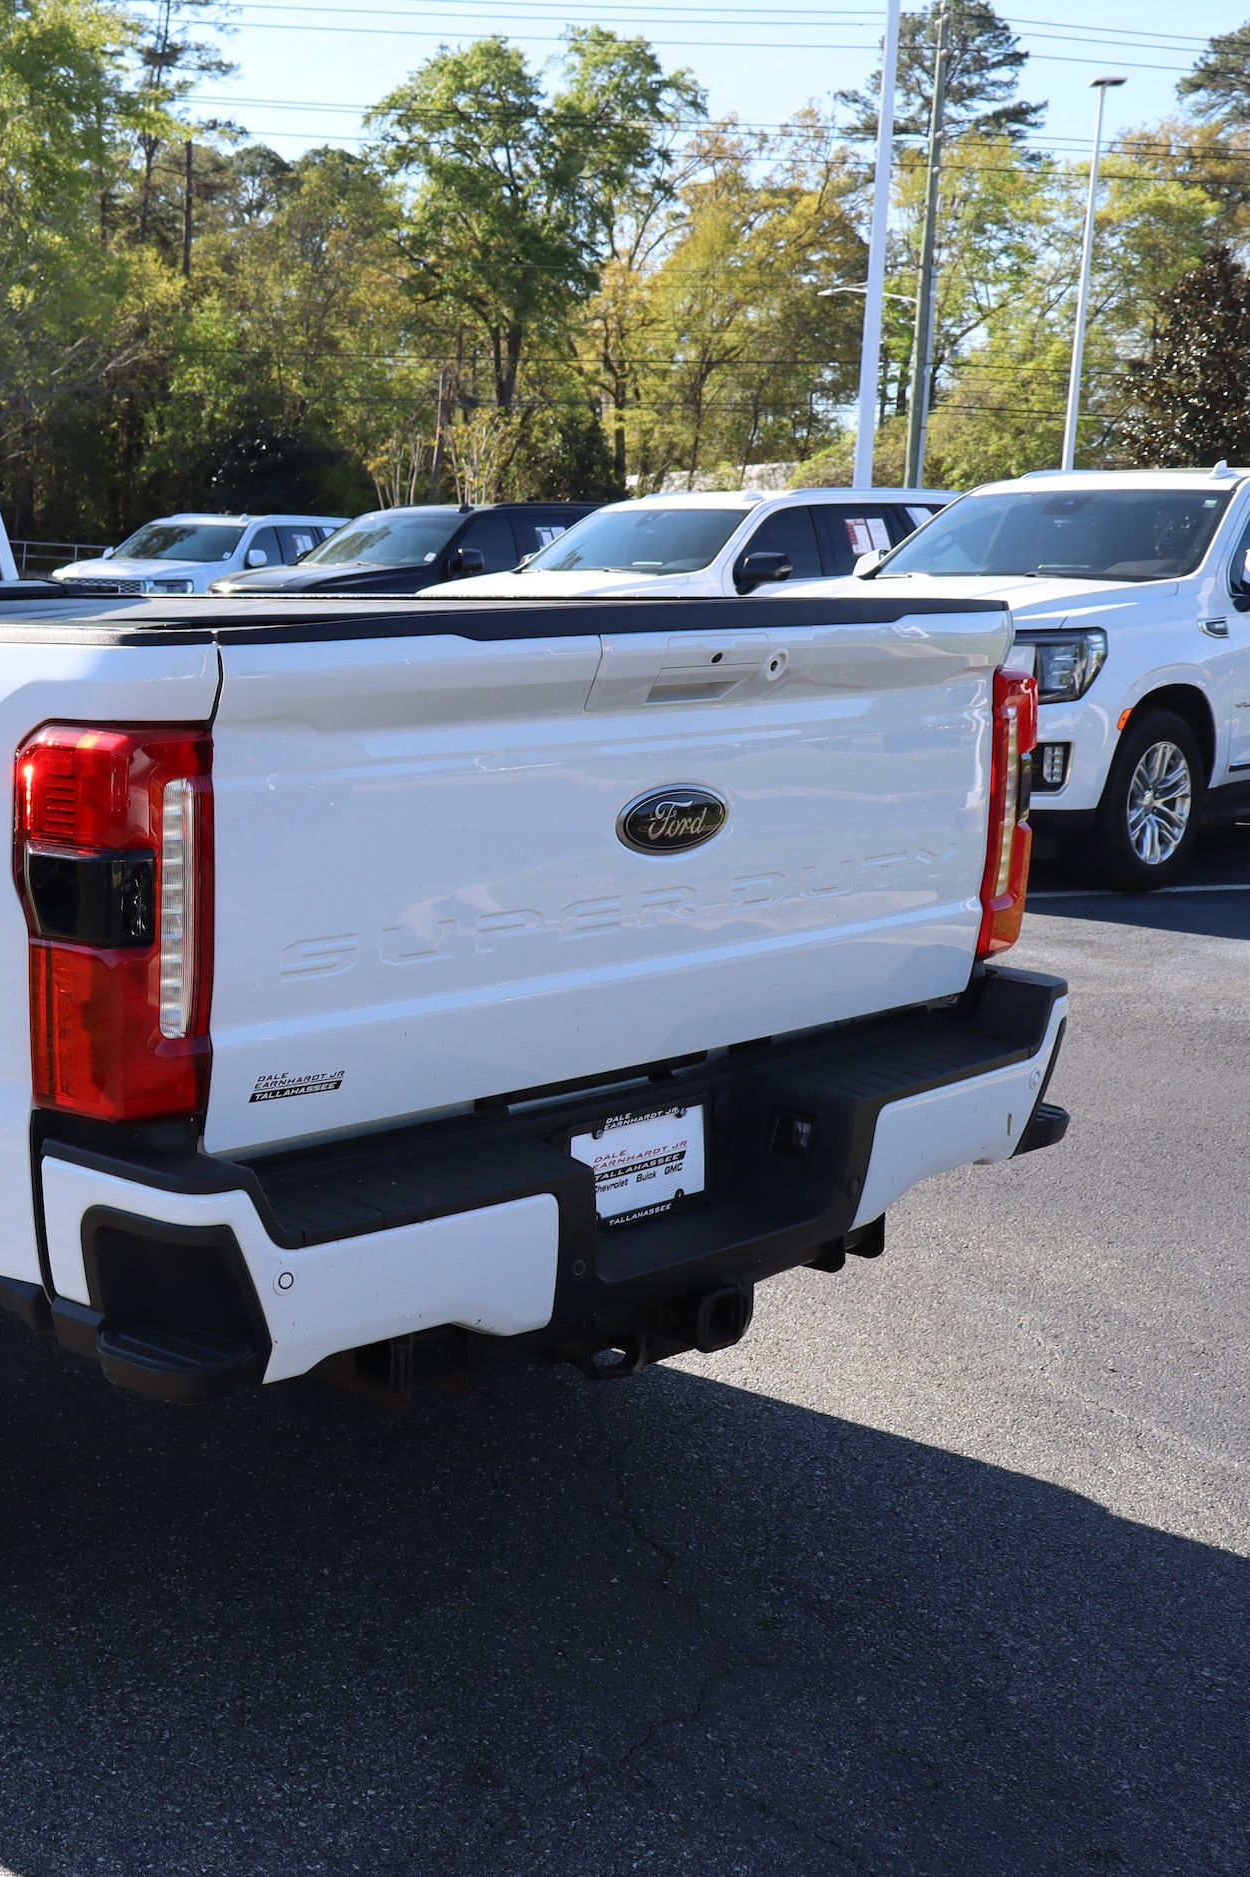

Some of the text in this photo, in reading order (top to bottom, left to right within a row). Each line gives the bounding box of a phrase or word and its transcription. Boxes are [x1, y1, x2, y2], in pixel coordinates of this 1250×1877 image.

[647, 799, 708, 840] Ford
[278, 842, 959, 984] SUPER DUTY
[254, 1070, 346, 1090] EARNHARDT JR
[257, 1072, 289, 1083] DALE
[255, 1082, 337, 1101] TALLAHASSEE
[603, 1106, 678, 1131] EARNHARDT JR
[605, 1113, 632, 1124] DALE
[593, 1140, 688, 1170] EARNHARDT JR
[594, 1150, 628, 1163] DALE
[595, 1154, 681, 1181] TALLAHASSEE
[636, 1170, 657, 1183] Buick
[664, 1162, 683, 1175] GMC
[608, 1203, 672, 1226] TALLAHASSEE
